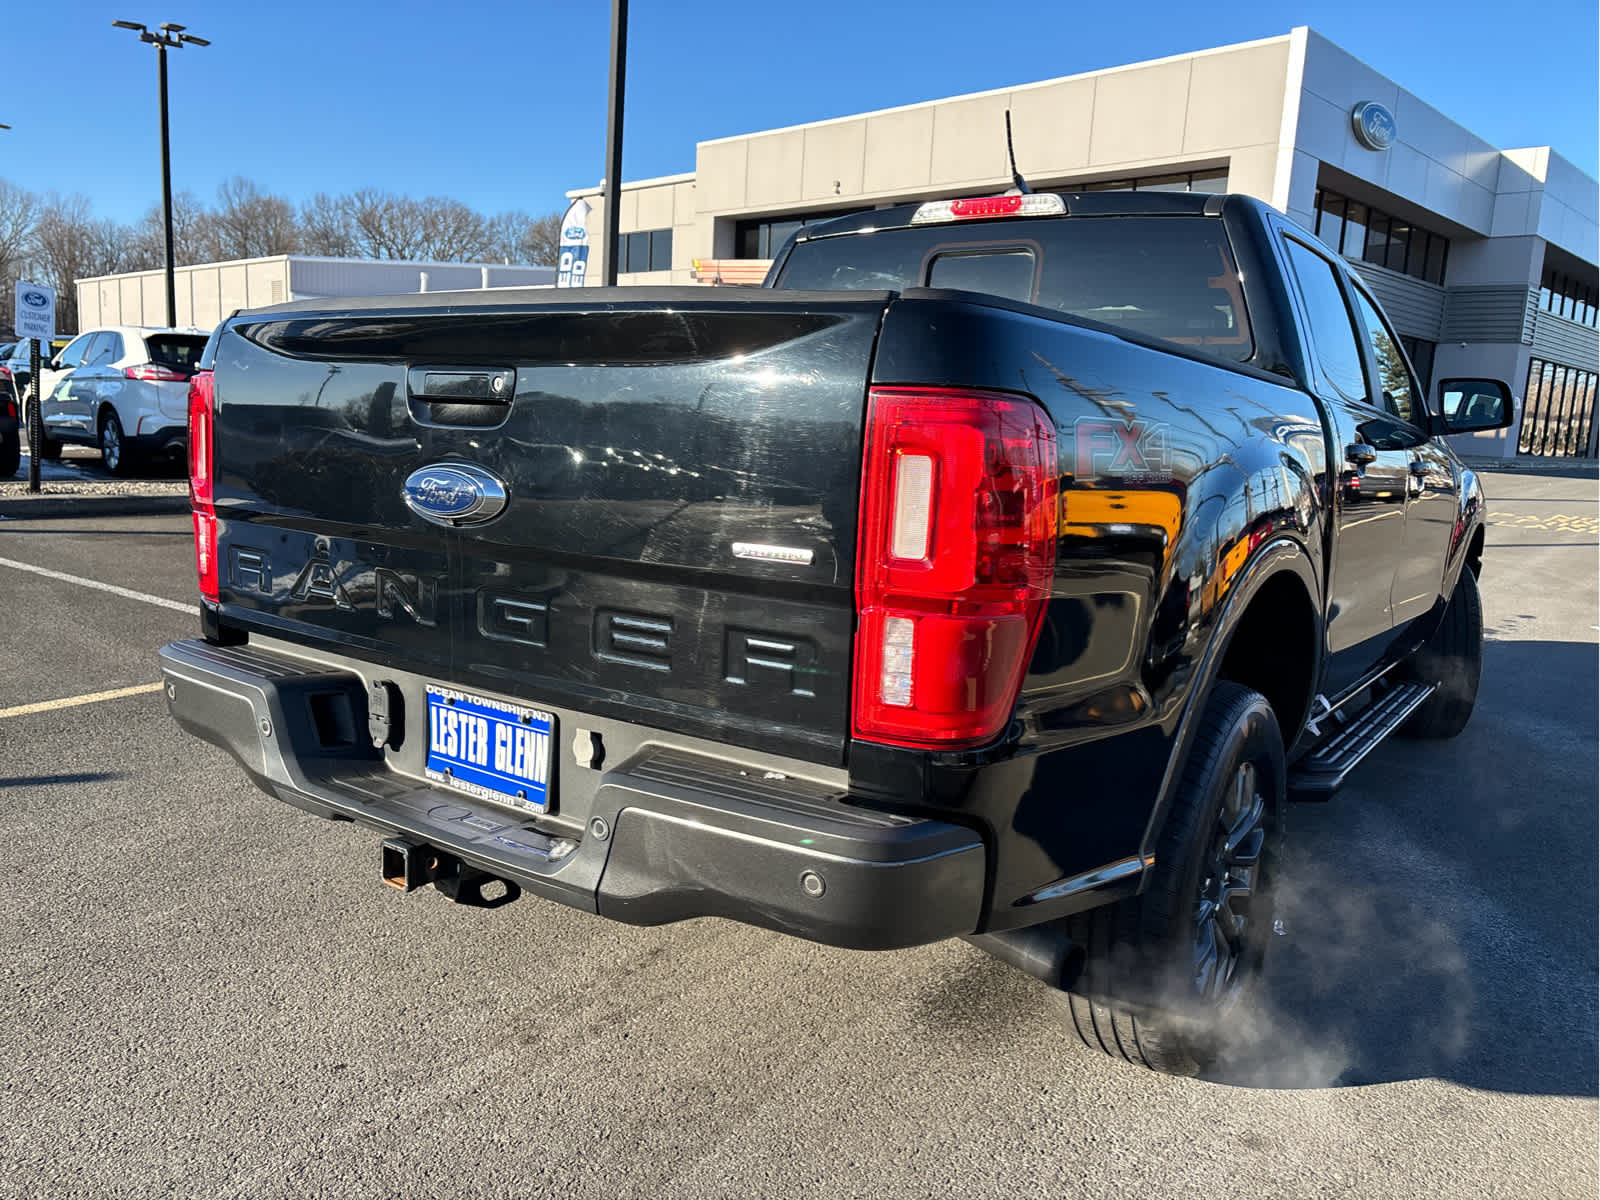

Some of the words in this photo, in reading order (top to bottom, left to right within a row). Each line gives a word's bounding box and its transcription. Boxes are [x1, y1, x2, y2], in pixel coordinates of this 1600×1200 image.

[1073, 415, 1172, 482] FX4
[228, 545, 818, 697] RANGER
[426, 684, 463, 701] OCEAN
[431, 706, 489, 767] LESTER
[495, 722, 550, 784] GLENN
